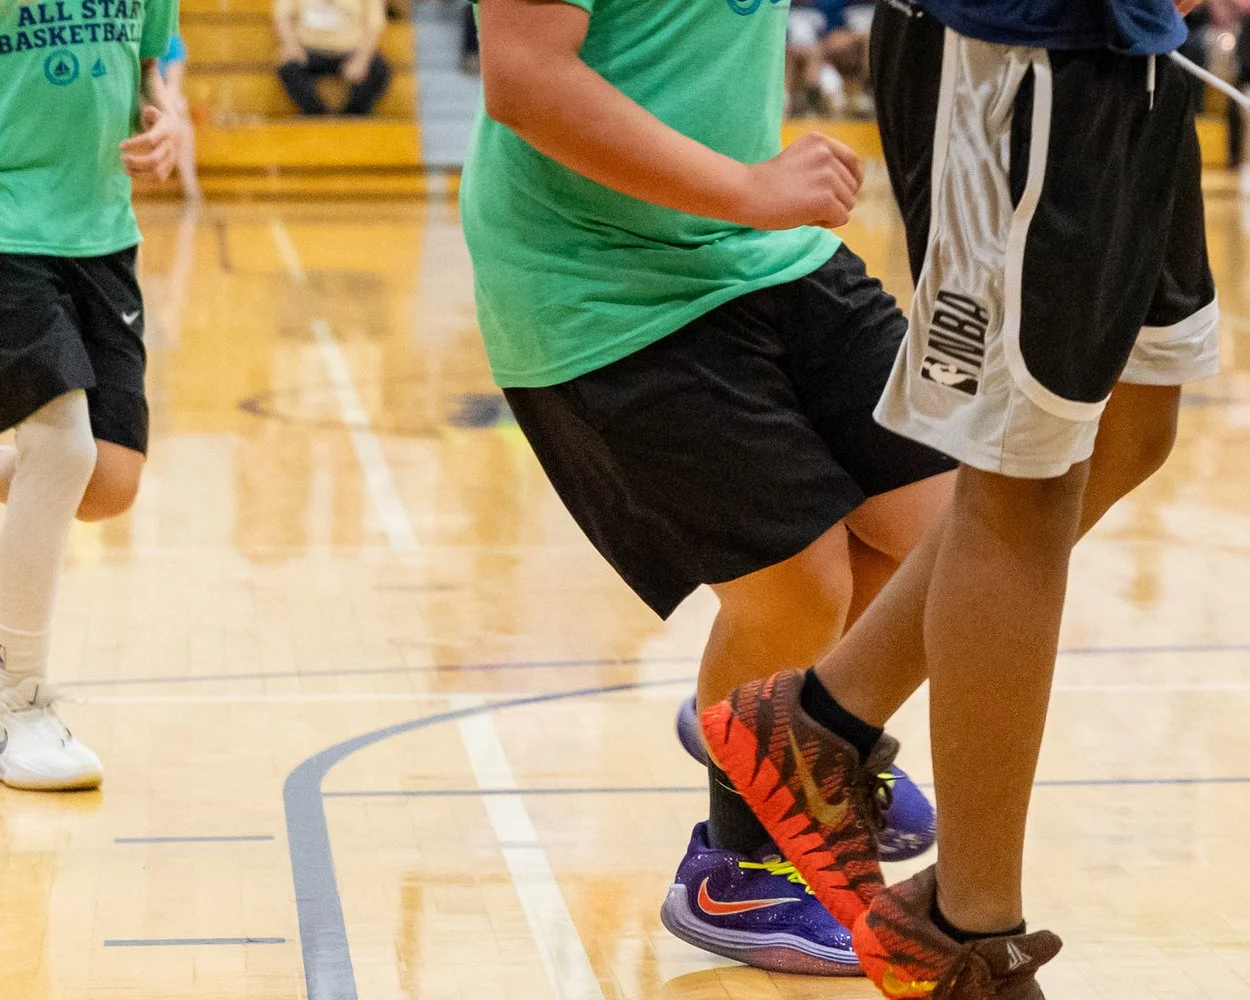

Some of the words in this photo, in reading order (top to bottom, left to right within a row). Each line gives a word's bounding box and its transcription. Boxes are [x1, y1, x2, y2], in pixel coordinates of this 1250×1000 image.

[18, 1, 73, 27] ALL
[0, 22, 141, 55] BASKETBAL
[927, 290, 990, 369] NBA
